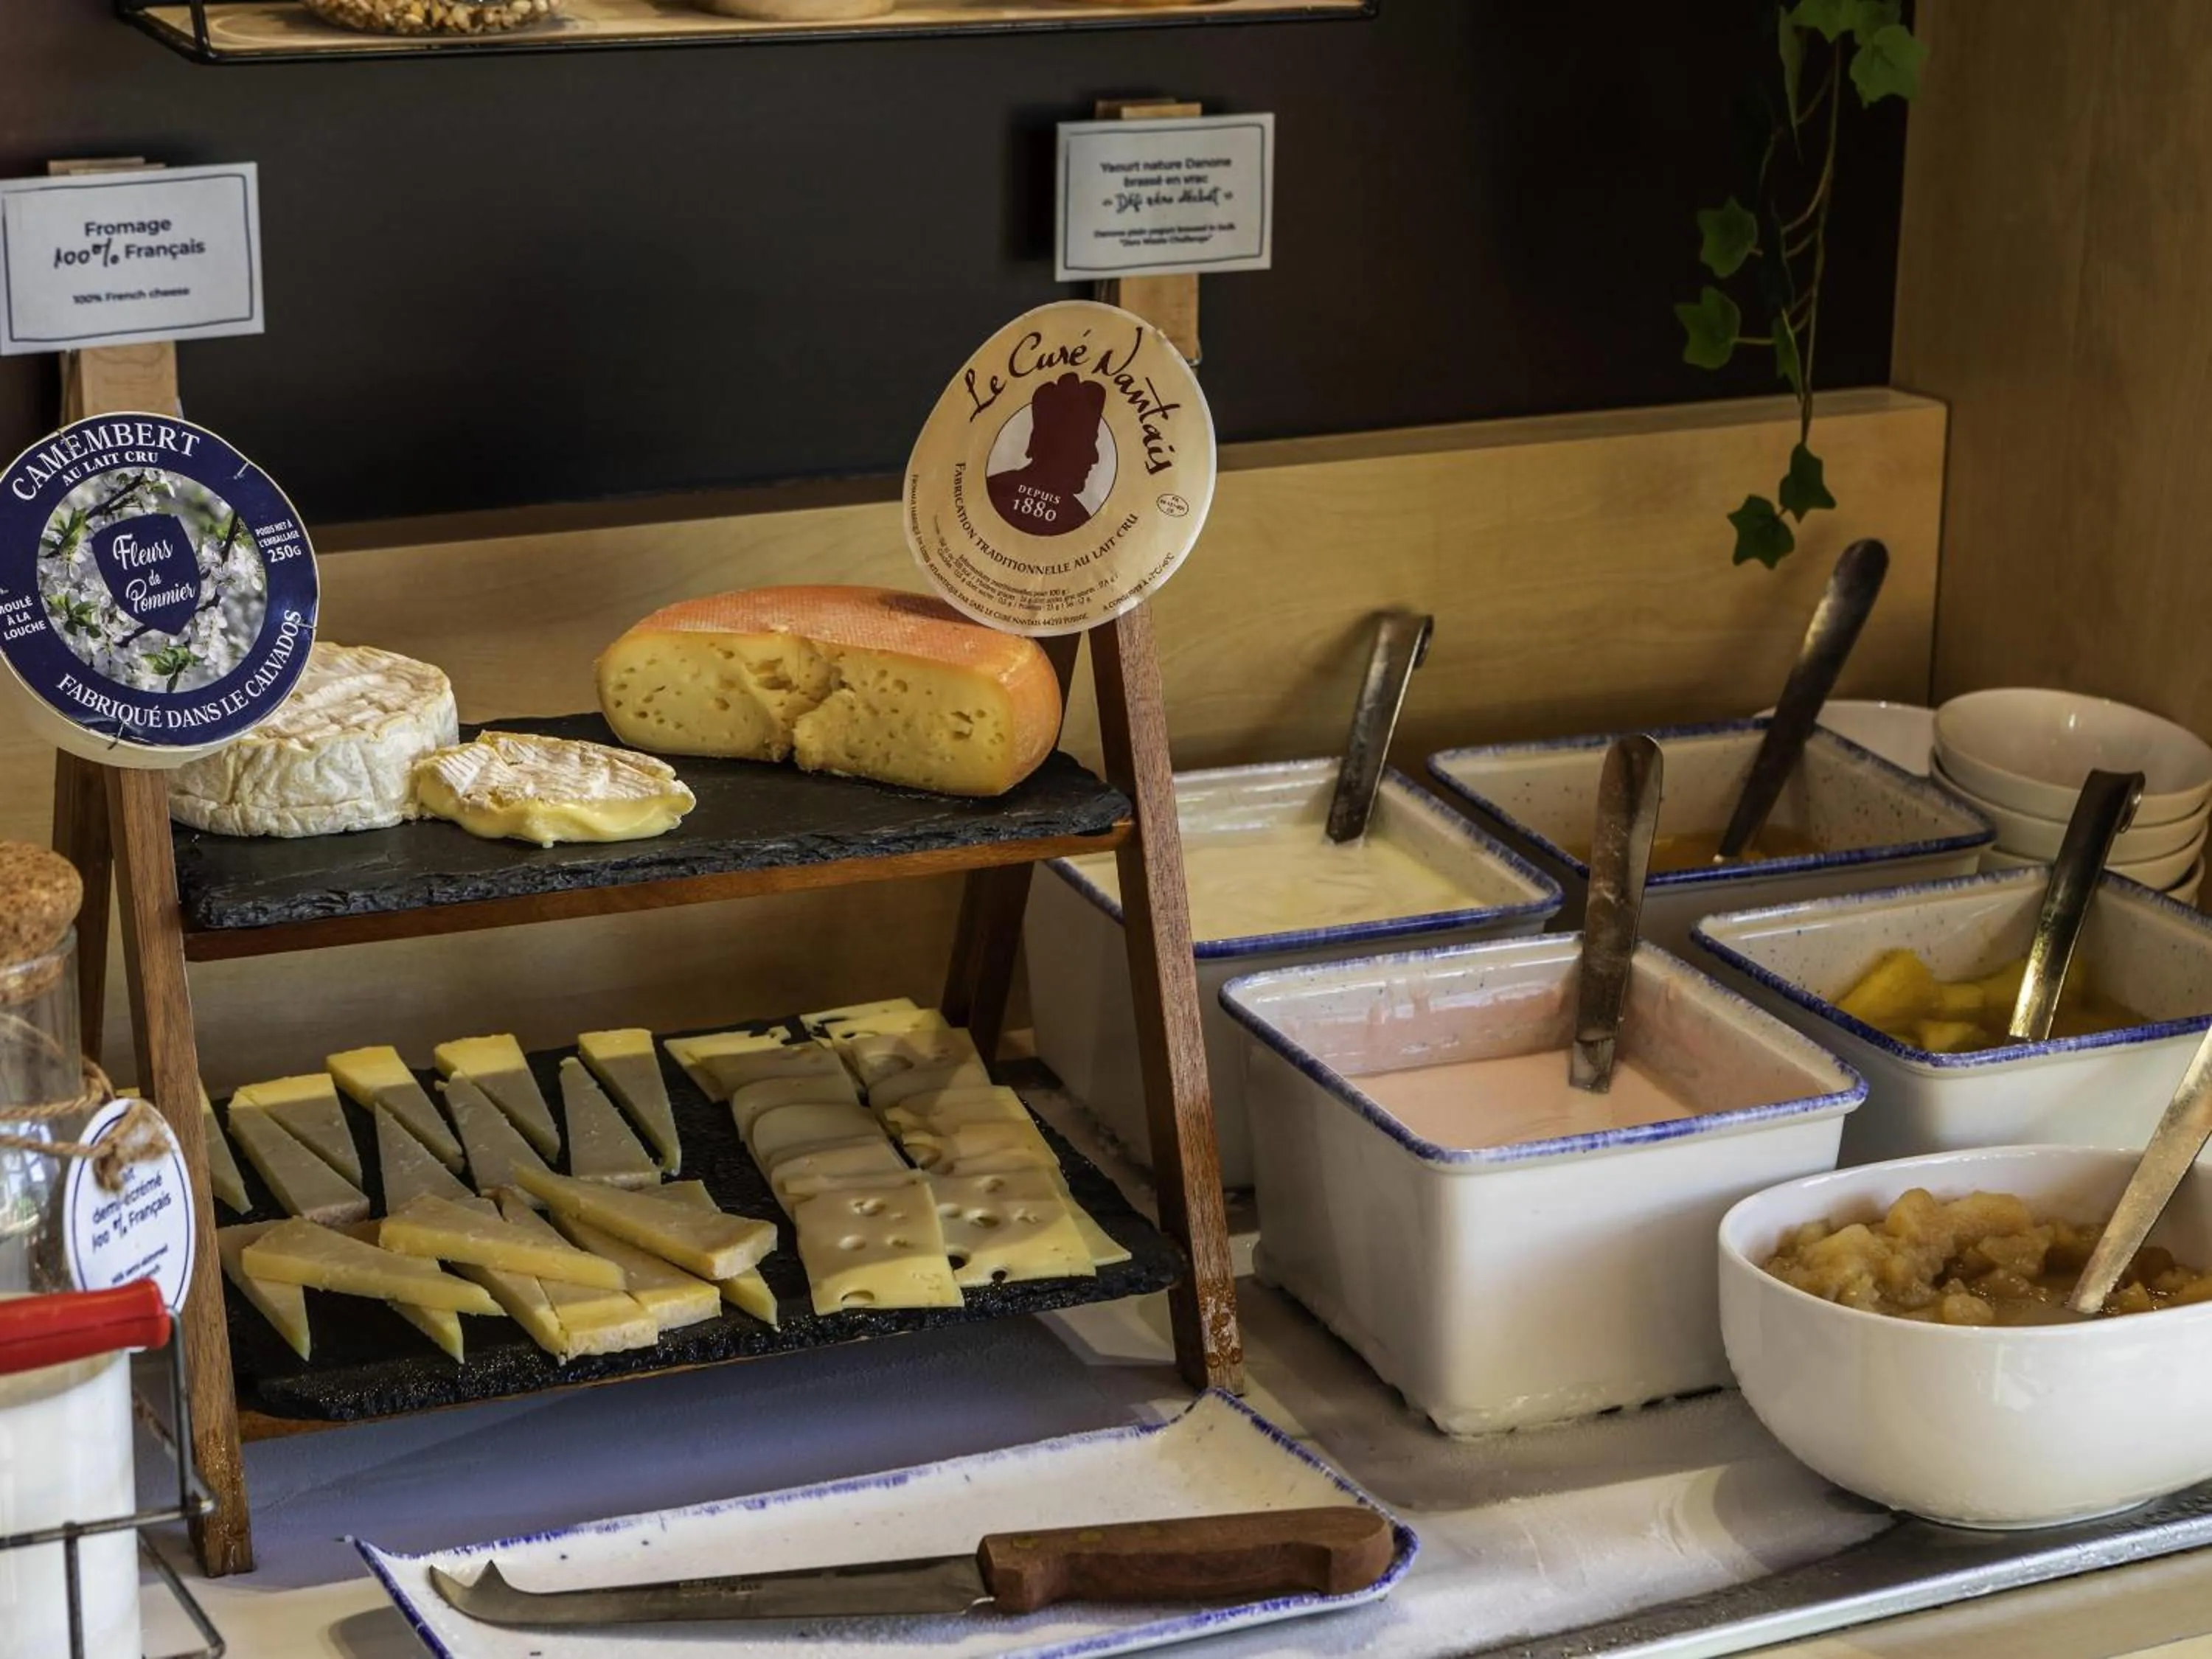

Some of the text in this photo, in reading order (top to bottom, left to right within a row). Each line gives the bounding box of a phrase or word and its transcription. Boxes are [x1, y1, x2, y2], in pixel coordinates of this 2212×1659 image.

[1143, 160, 1182, 171] nature
[1185, 158, 1232, 169] Danone
[1166, 177, 1181, 185] en
[85, 218, 173, 238] Fromage
[54, 237, 206, 268] 100% Français
[105, 289, 146, 303] French
[148, 286, 191, 298] cheese
[964, 326, 1181, 476] Le Curé Nantais
[12, 422, 201, 502] CAMEMBERT
[62, 451, 160, 487] AU LAIT CRU
[1017, 484, 1062, 505] DEPUIS
[954, 461, 975, 541] FABRICATION
[974, 537, 1071, 575] TRADITIONNELLE
[1074, 556, 1091, 569] AU
[1091, 536, 1116, 560] LAIT
[1116, 512, 1140, 540] CRU
[1012, 498, 1057, 523] 1880
[254, 524, 276, 538] POIDS
[112, 534, 175, 571] Fleurs
[266, 544, 302, 563] 250G
[147, 569, 162, 585] de
[125, 578, 197, 615] Pommier
[15, 611, 32, 623] LA
[3, 620, 46, 641] LOUCHE
[55, 609, 302, 729] FABRIQUÉ DANS LE CALVADOS
[128, 1190, 172, 1228] Français
